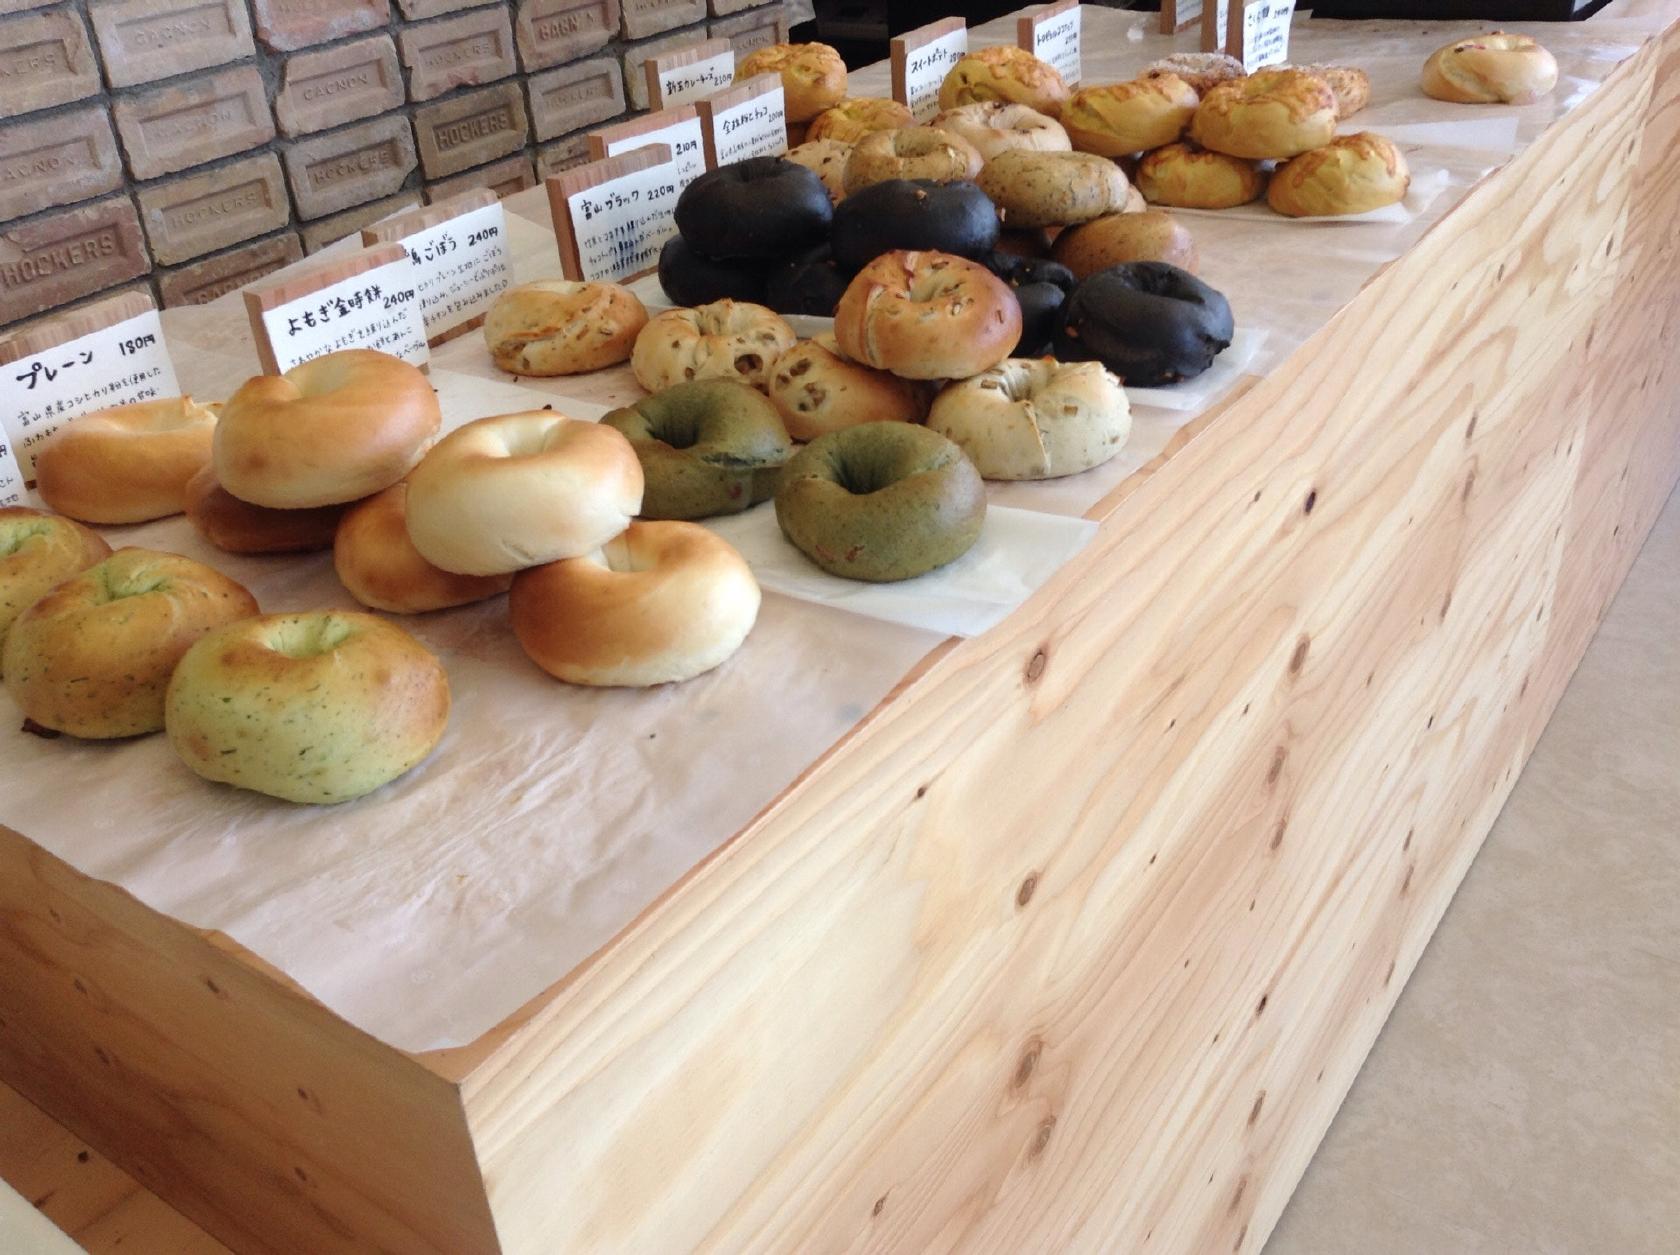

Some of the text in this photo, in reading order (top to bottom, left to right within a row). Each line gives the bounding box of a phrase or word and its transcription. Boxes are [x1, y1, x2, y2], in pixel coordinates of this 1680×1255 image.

[436, 112, 510, 149] HOCKERS
[676, 140, 697, 155] 210円
[581, 185, 674, 220] 富山ブラック 220円
[468, 226, 499, 247] 240円
[2, 233, 115, 290] HOCKERS
[289, 285, 415, 336] よもぎ金時餅 240円
[16, 334, 156, 389] プレーン 180円
